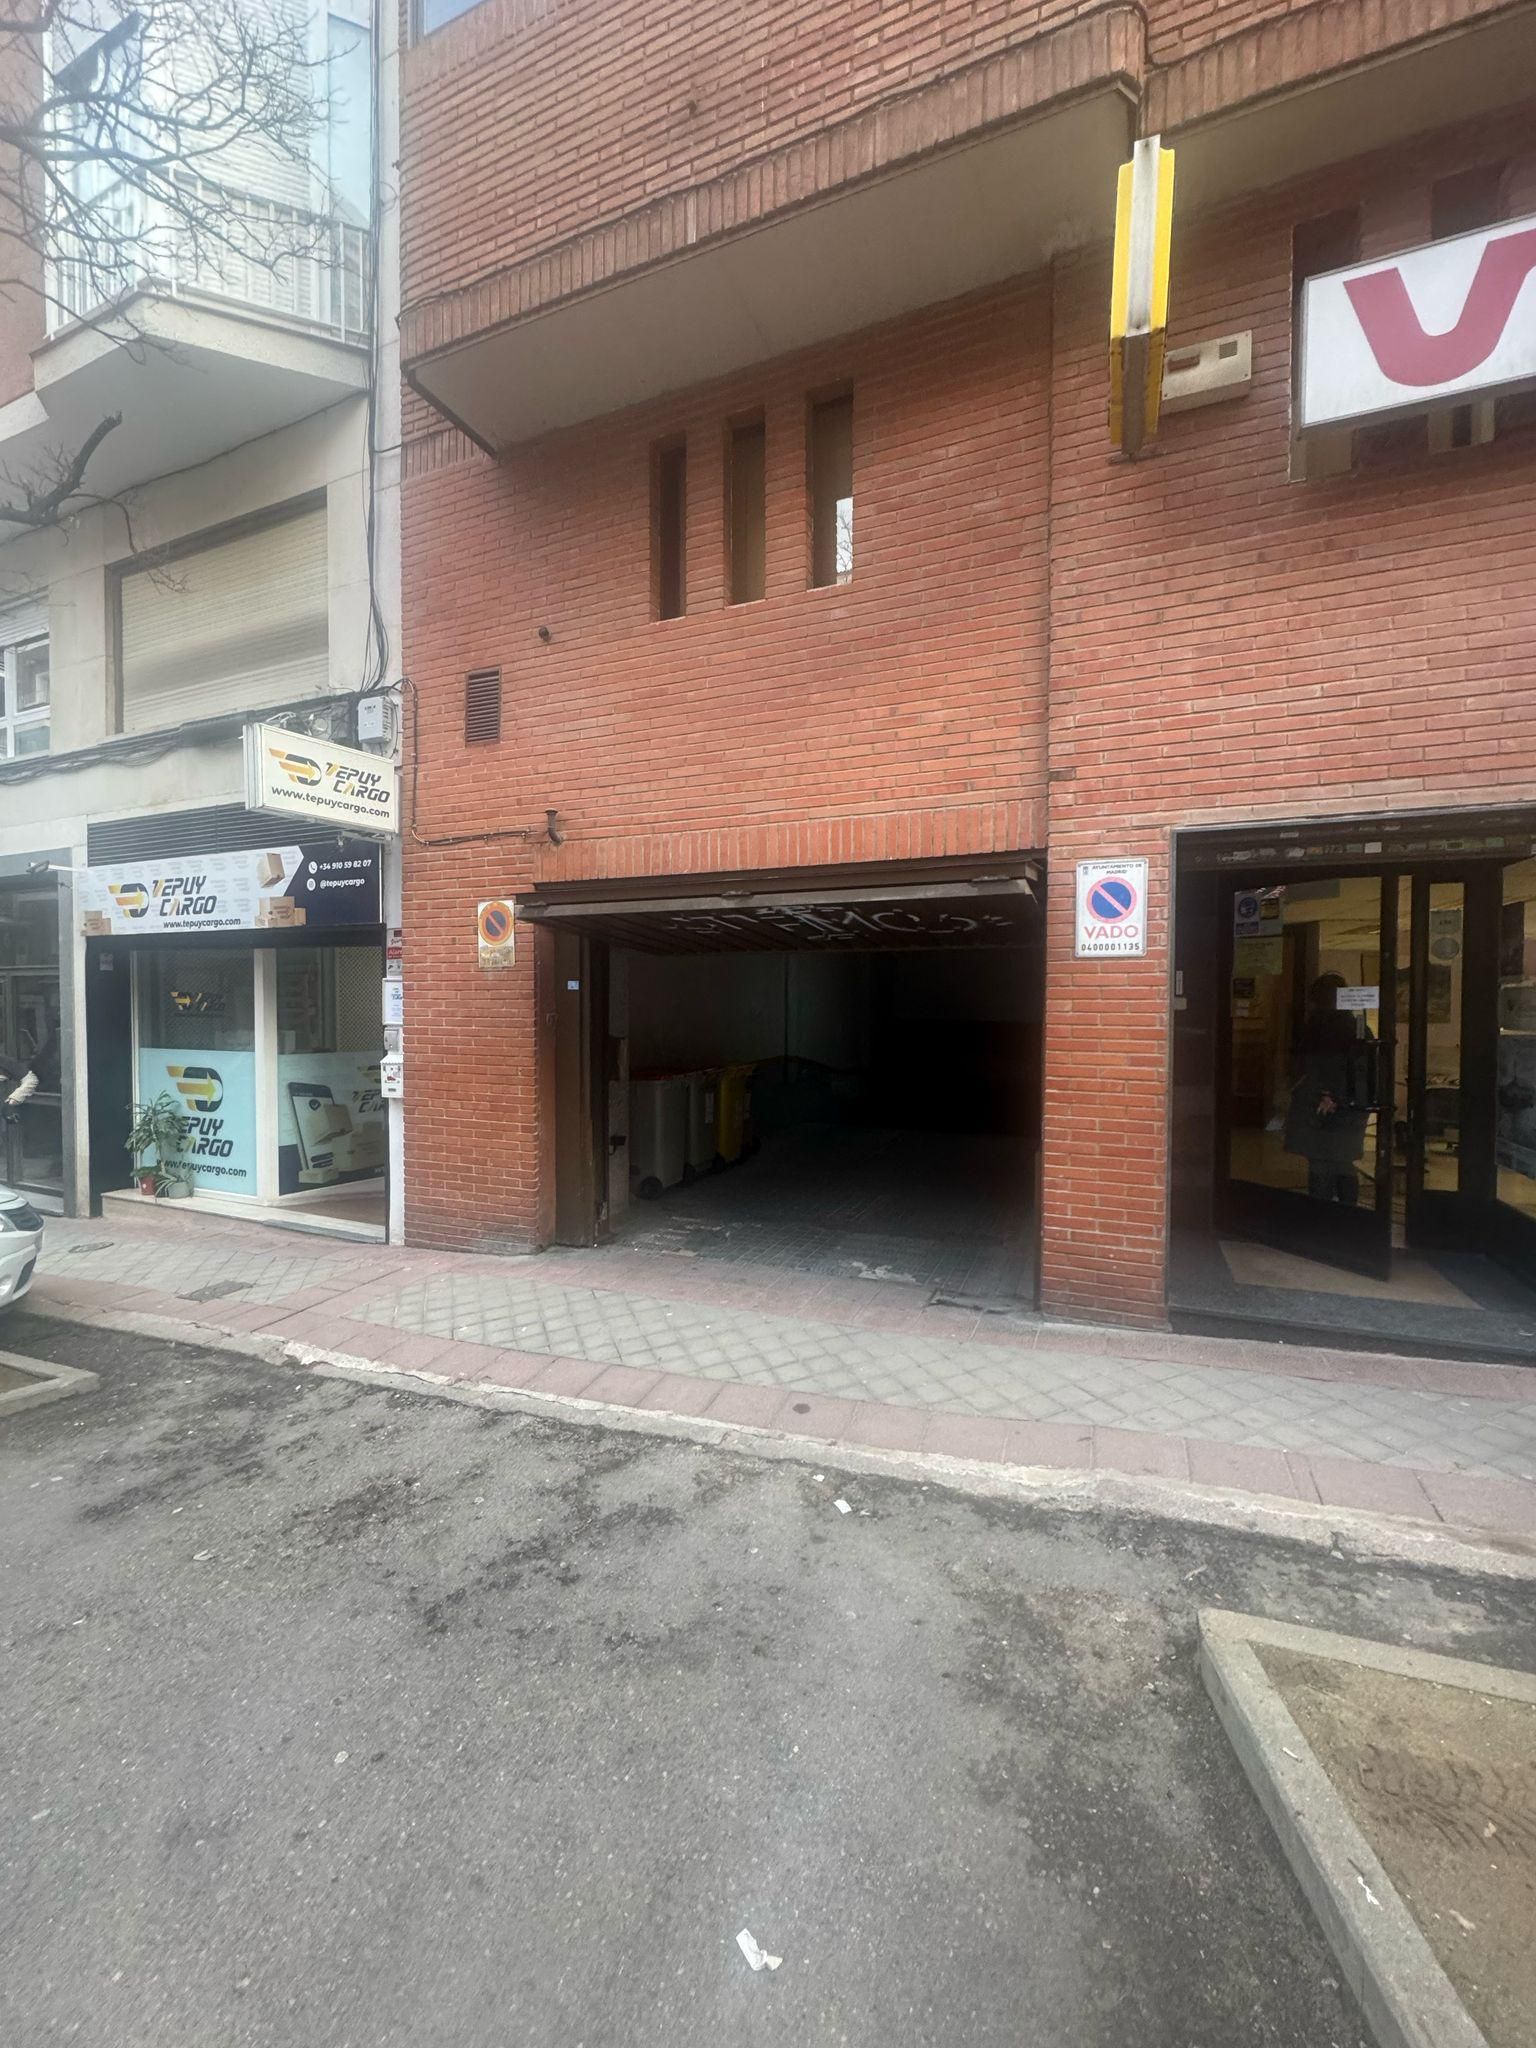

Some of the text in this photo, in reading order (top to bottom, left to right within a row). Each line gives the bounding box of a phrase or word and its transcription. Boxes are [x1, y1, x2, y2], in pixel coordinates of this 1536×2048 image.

[1343, 228, 1536, 387] V
[325, 762, 381, 787] TEPUY
[271, 786, 390, 818] www.tepuycargo.com
[333, 780, 390, 803] CARGO
[331, 861, 343, 869] 910
[353, 860, 362, 868] 82
[362, 859, 372, 867] 07
[152, 875, 207, 897] TEPUY
[320, 879, 365, 889] @tepuycargo
[159, 895, 217, 917] CARGO
[163, 918, 241, 929] www.tepuycargo.com
[1084, 925, 1139, 939] VADO
[1082, 943, 1140, 951] 0400001135
[178, 1116, 224, 1137] EPUY
